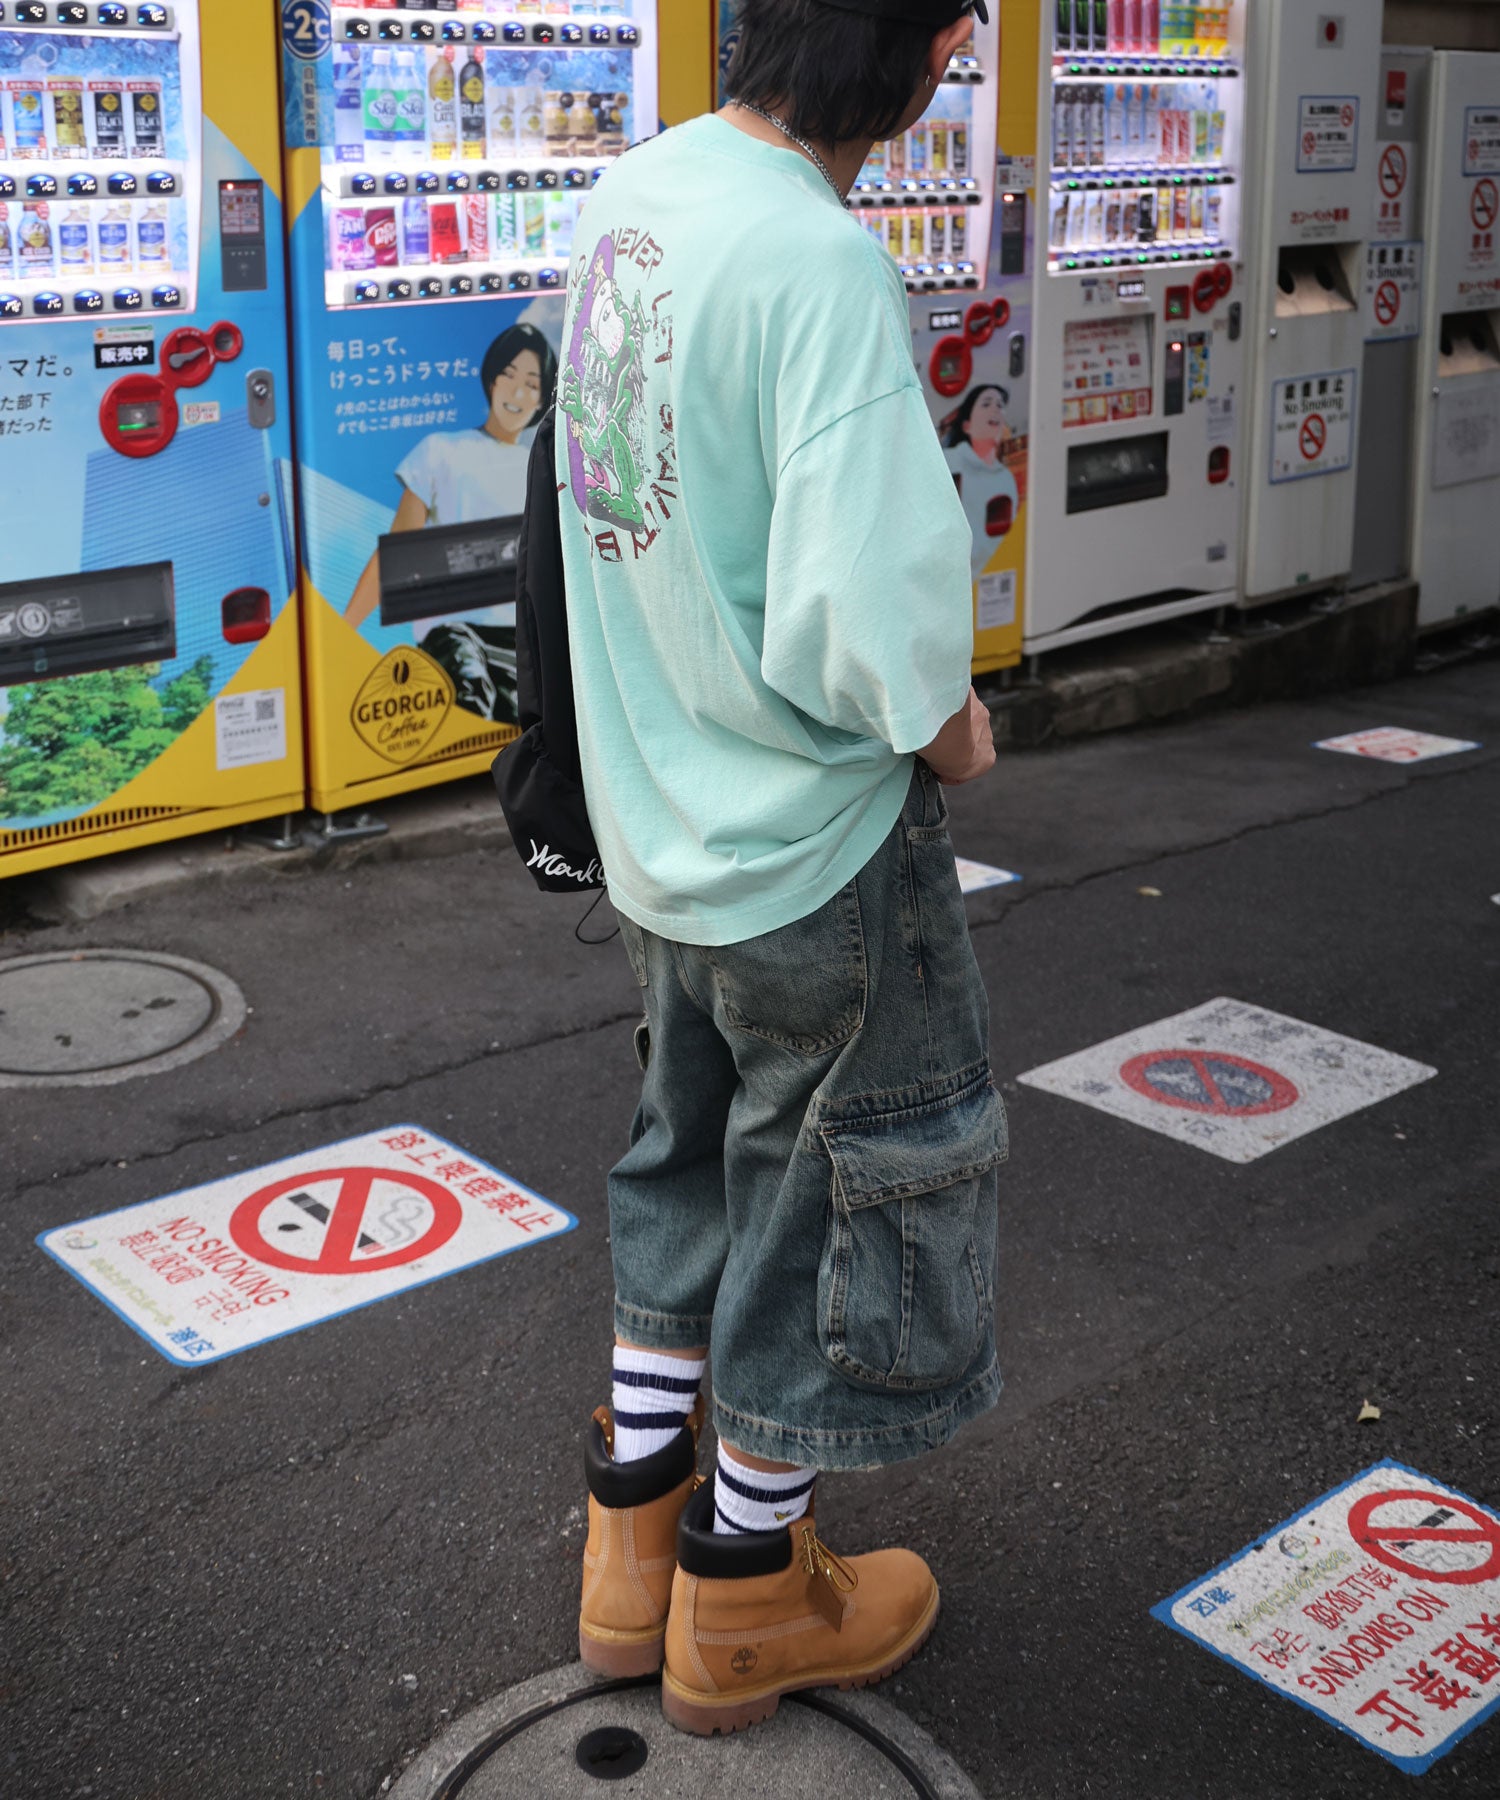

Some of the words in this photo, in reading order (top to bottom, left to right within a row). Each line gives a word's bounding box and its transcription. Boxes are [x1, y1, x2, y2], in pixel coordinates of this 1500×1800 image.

[610, 227, 664, 281] NEVER
[0, 355, 73, 377] マだ。
[100, 344, 149, 364] 販売中
[327, 336, 407, 362] 毎日って、
[329, 358, 480, 390] けっこうドラマだ。
[631, 403, 678, 560] GRAVITY
[357, 688, 446, 724] GEORGIA
[377, 716, 429, 744] Coffee
[379, 1131, 554, 1233] 路上喫煙禁止
[157, 1216, 207, 1242] NO
[187, 1237, 290, 1307] SMOKING
[194, 1287, 252, 1322] 금연
[165, 1326, 217, 1358] 港区
[1395, 1586, 1451, 1623] NO
[1296, 1612, 1415, 1697] SMOKING
